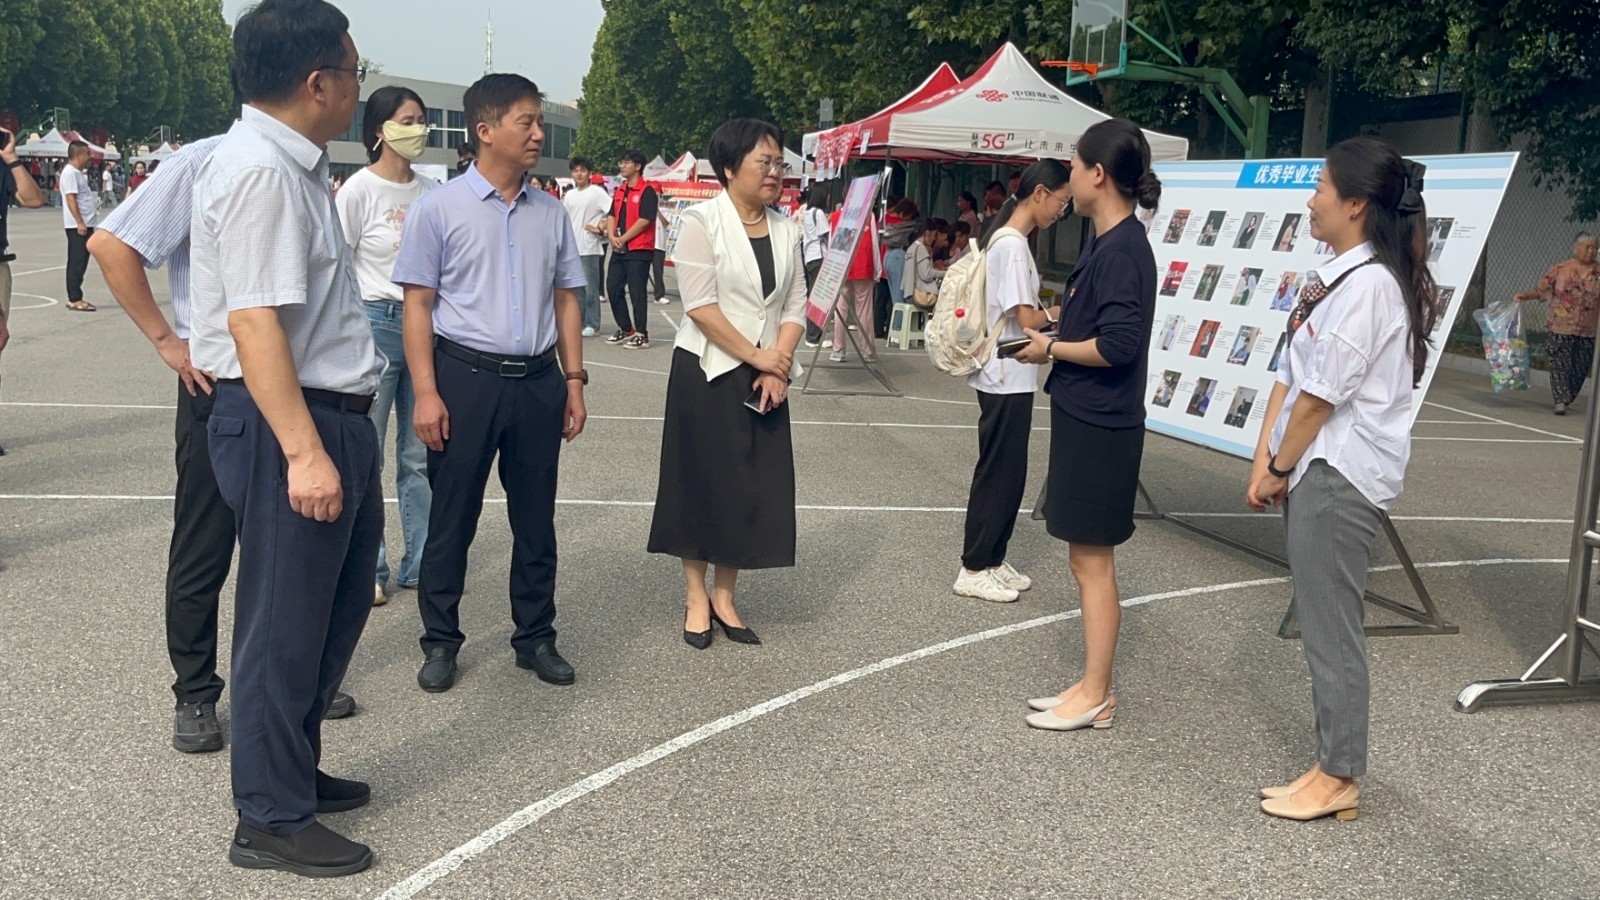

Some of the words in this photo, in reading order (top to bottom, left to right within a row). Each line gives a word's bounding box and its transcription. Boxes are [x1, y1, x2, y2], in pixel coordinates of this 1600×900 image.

[1254, 164, 1321, 184] 优秀毕业生
